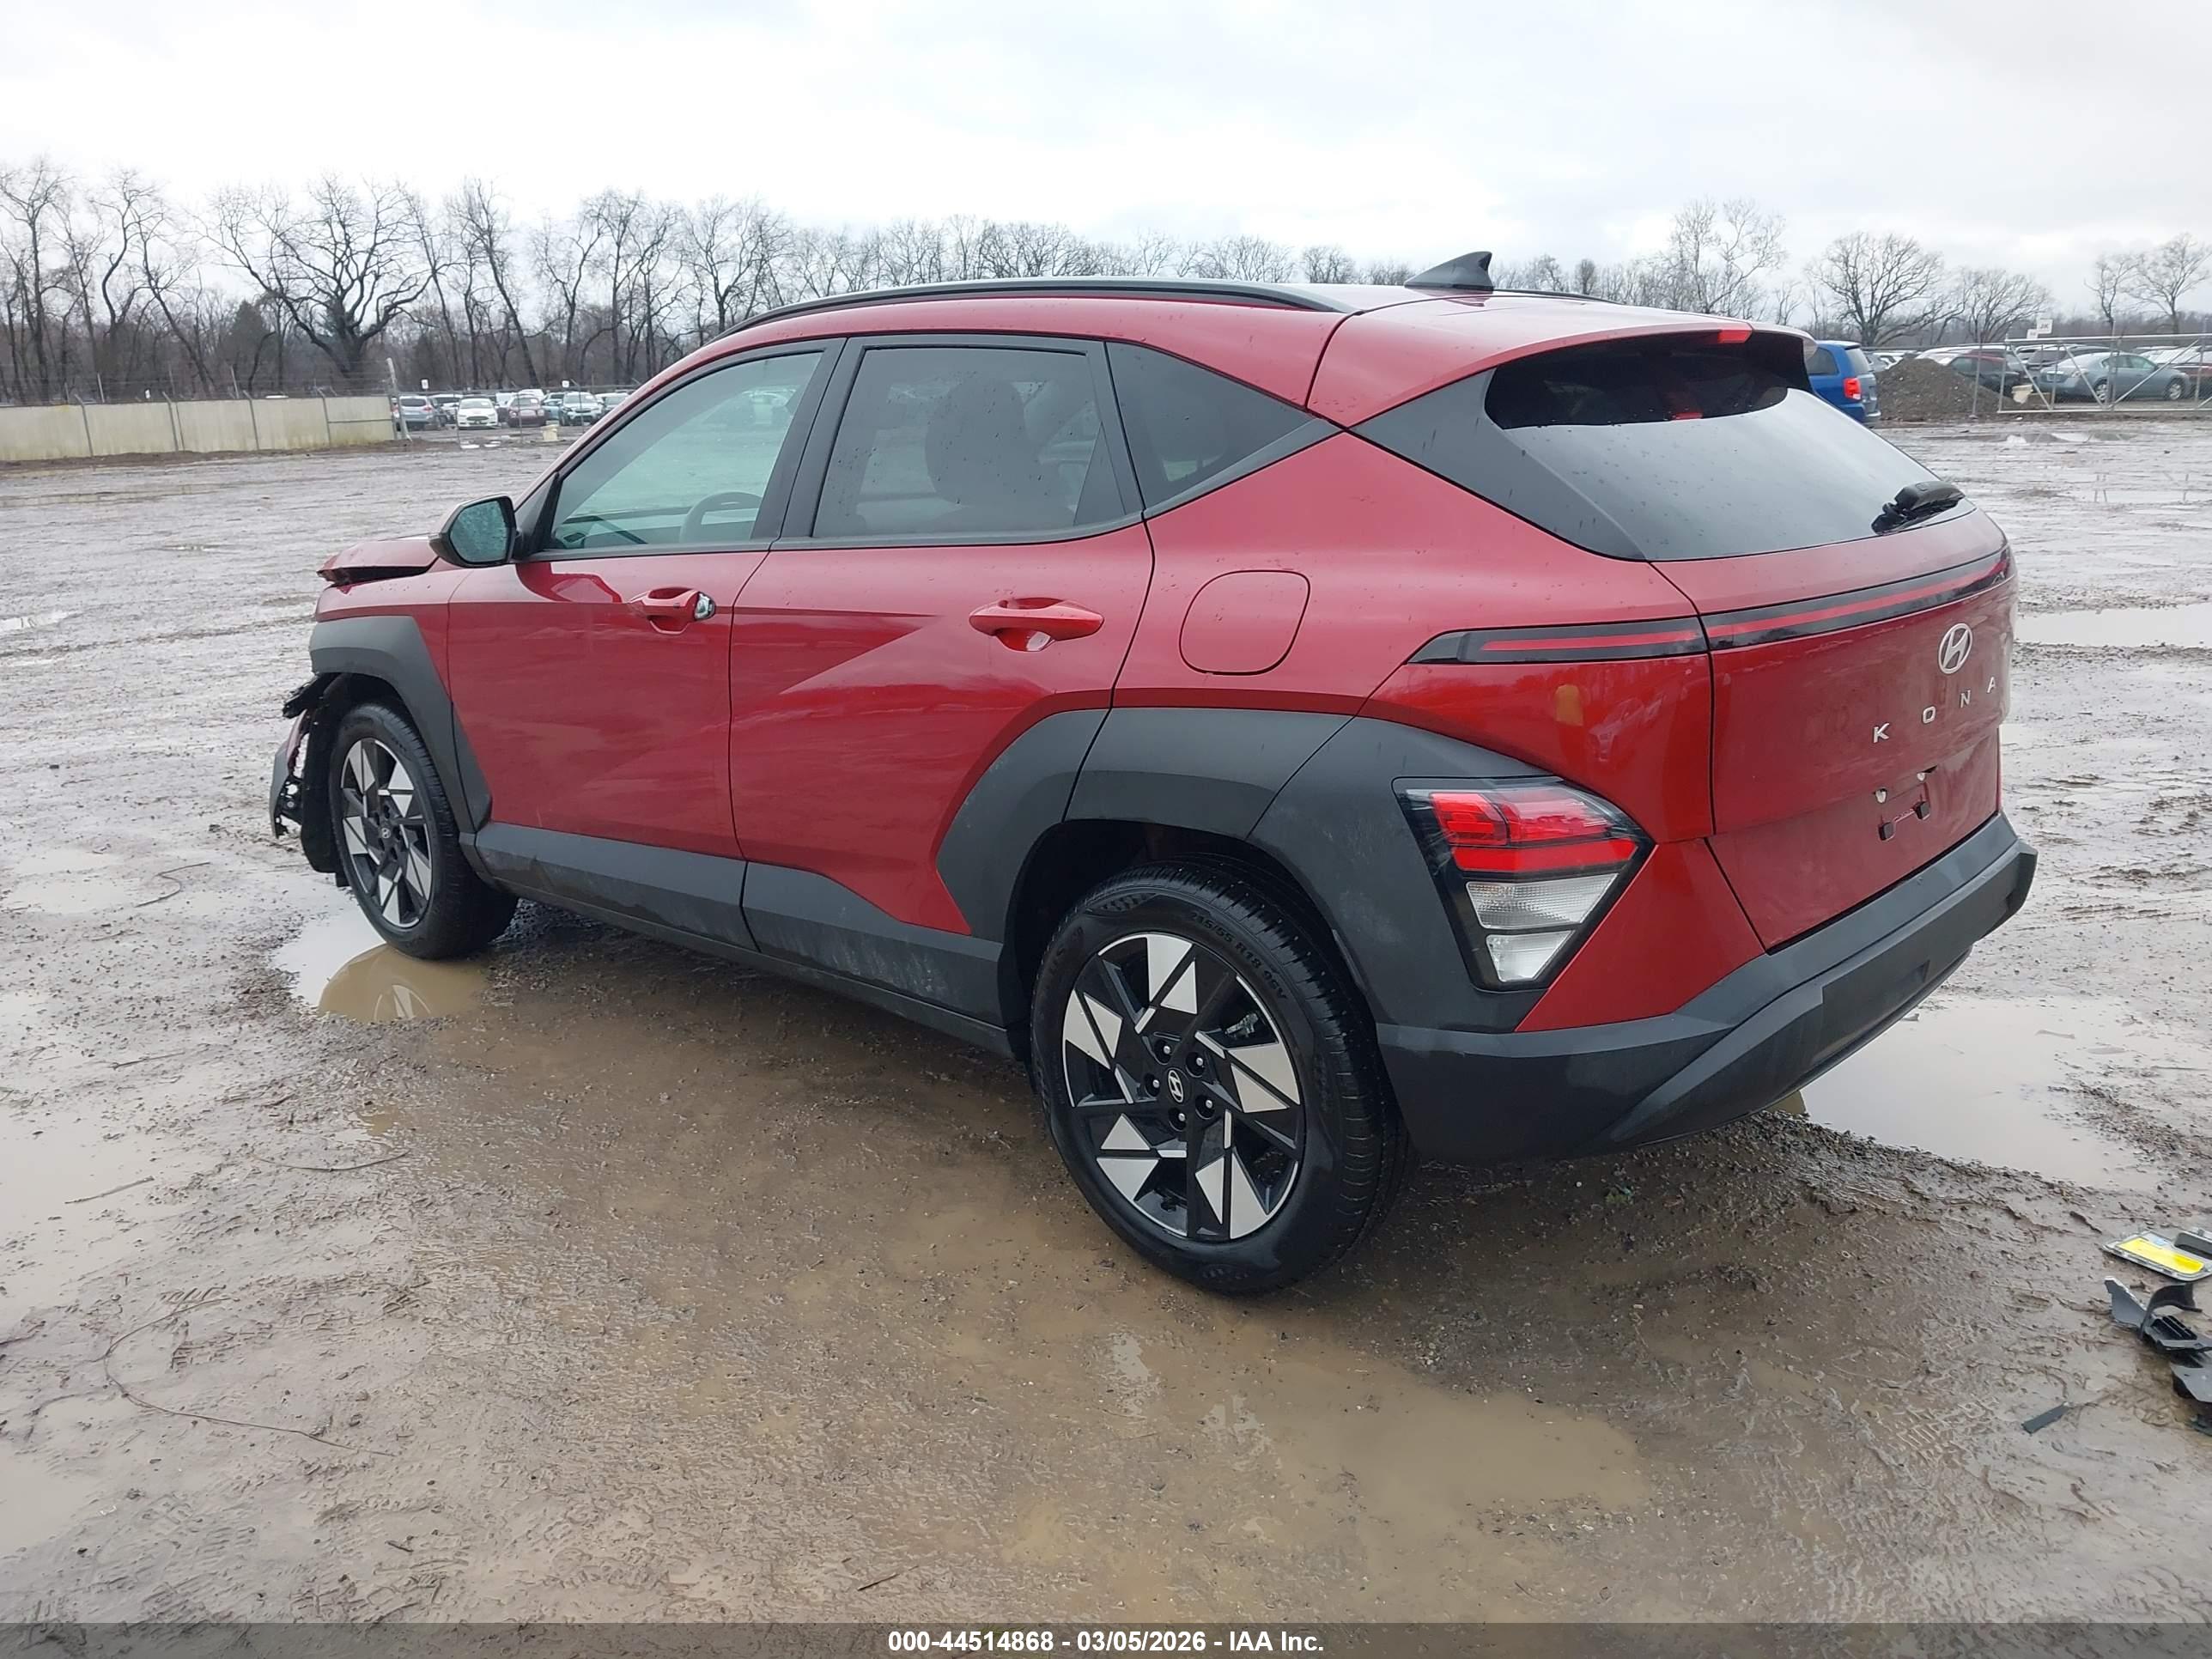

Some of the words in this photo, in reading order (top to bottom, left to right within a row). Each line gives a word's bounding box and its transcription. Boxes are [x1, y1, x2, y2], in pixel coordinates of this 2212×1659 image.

[1873, 676, 1996, 744] KONA
[1190, 911, 1236, 943] 215/55
[1235, 941, 1262, 969] R18
